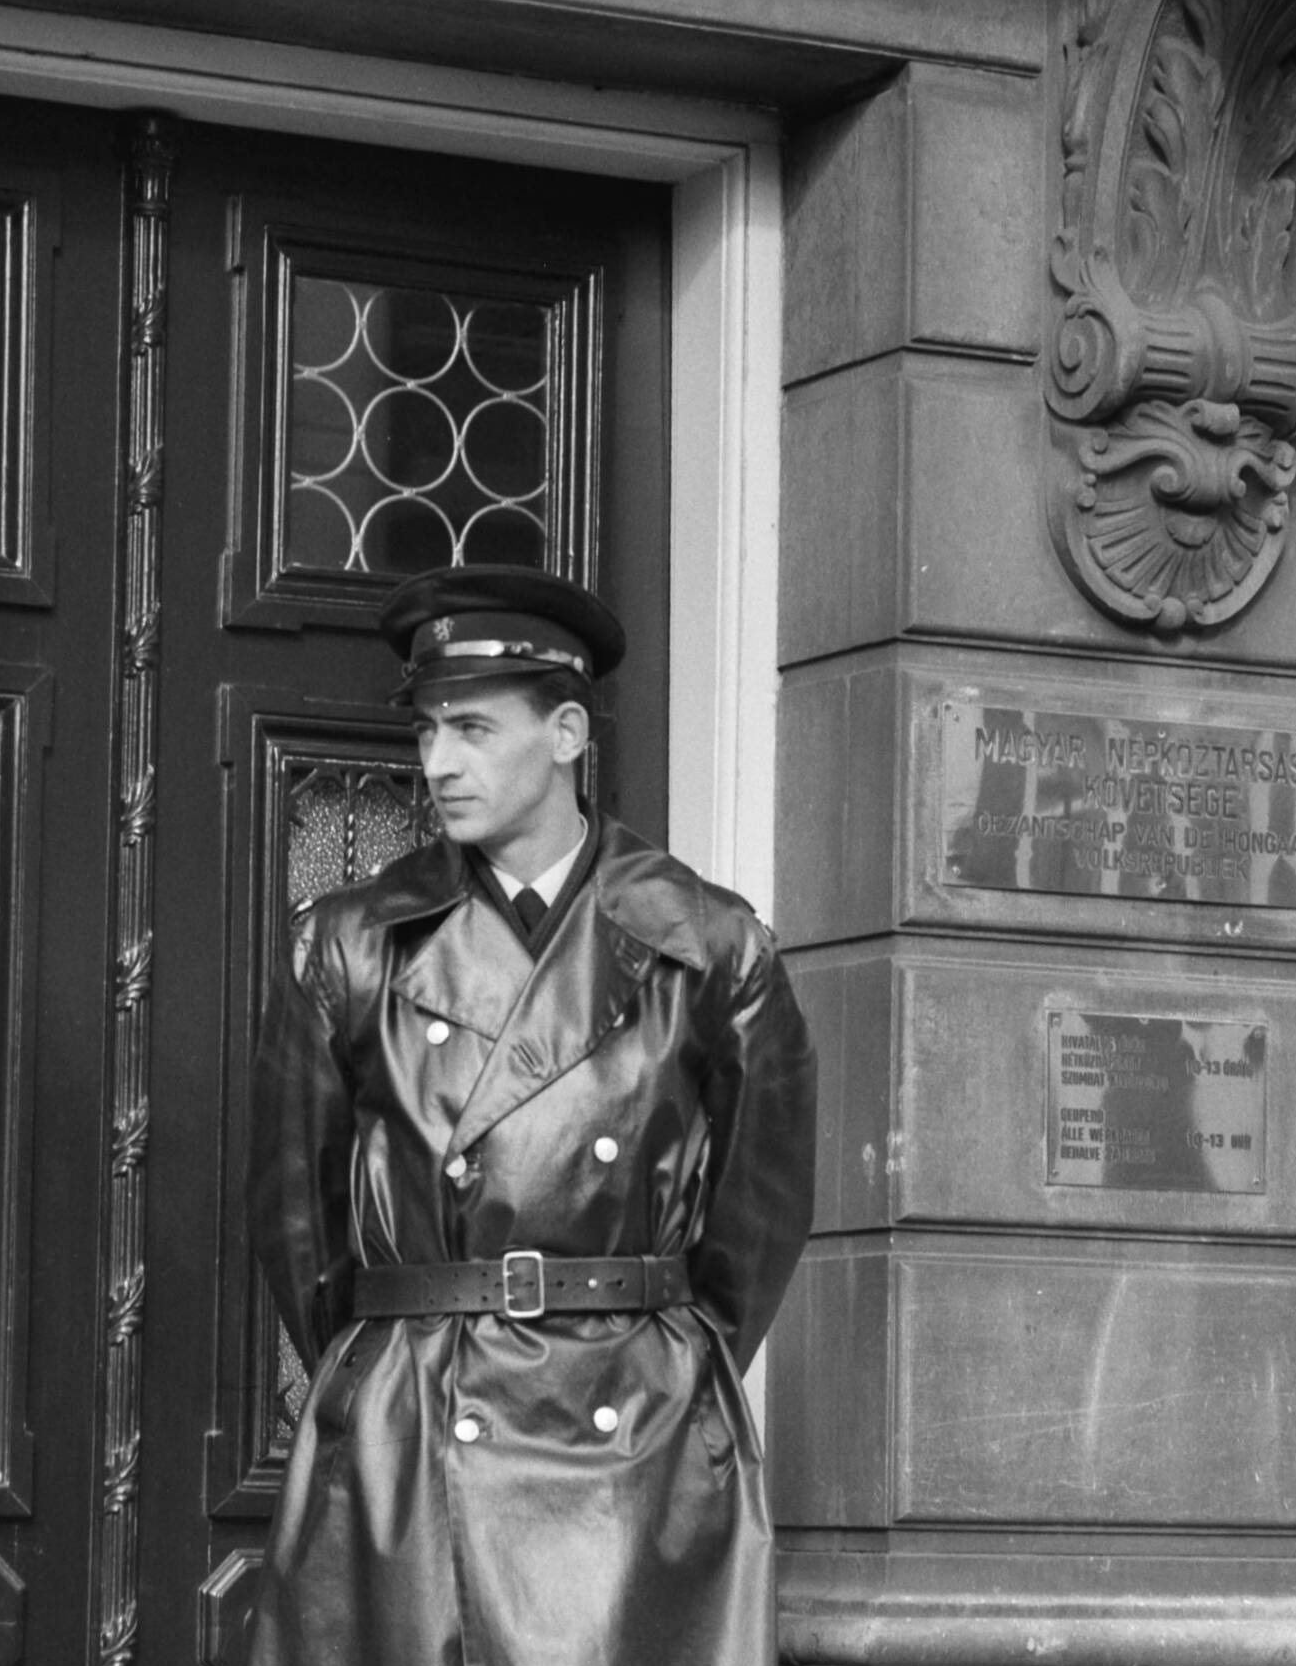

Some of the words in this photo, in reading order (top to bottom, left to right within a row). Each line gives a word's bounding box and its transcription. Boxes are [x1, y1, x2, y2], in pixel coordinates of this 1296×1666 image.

[975, 727, 1085, 769] MAGYAR
[977, 813, 1125, 843] GEZANTSCHAP
[1134, 821, 1173, 847] VAN
[1185, 827, 1211, 849] DE
[1061, 1125, 1085, 1141] ALLE
[1185, 1132, 1224, 1150] 10-13
